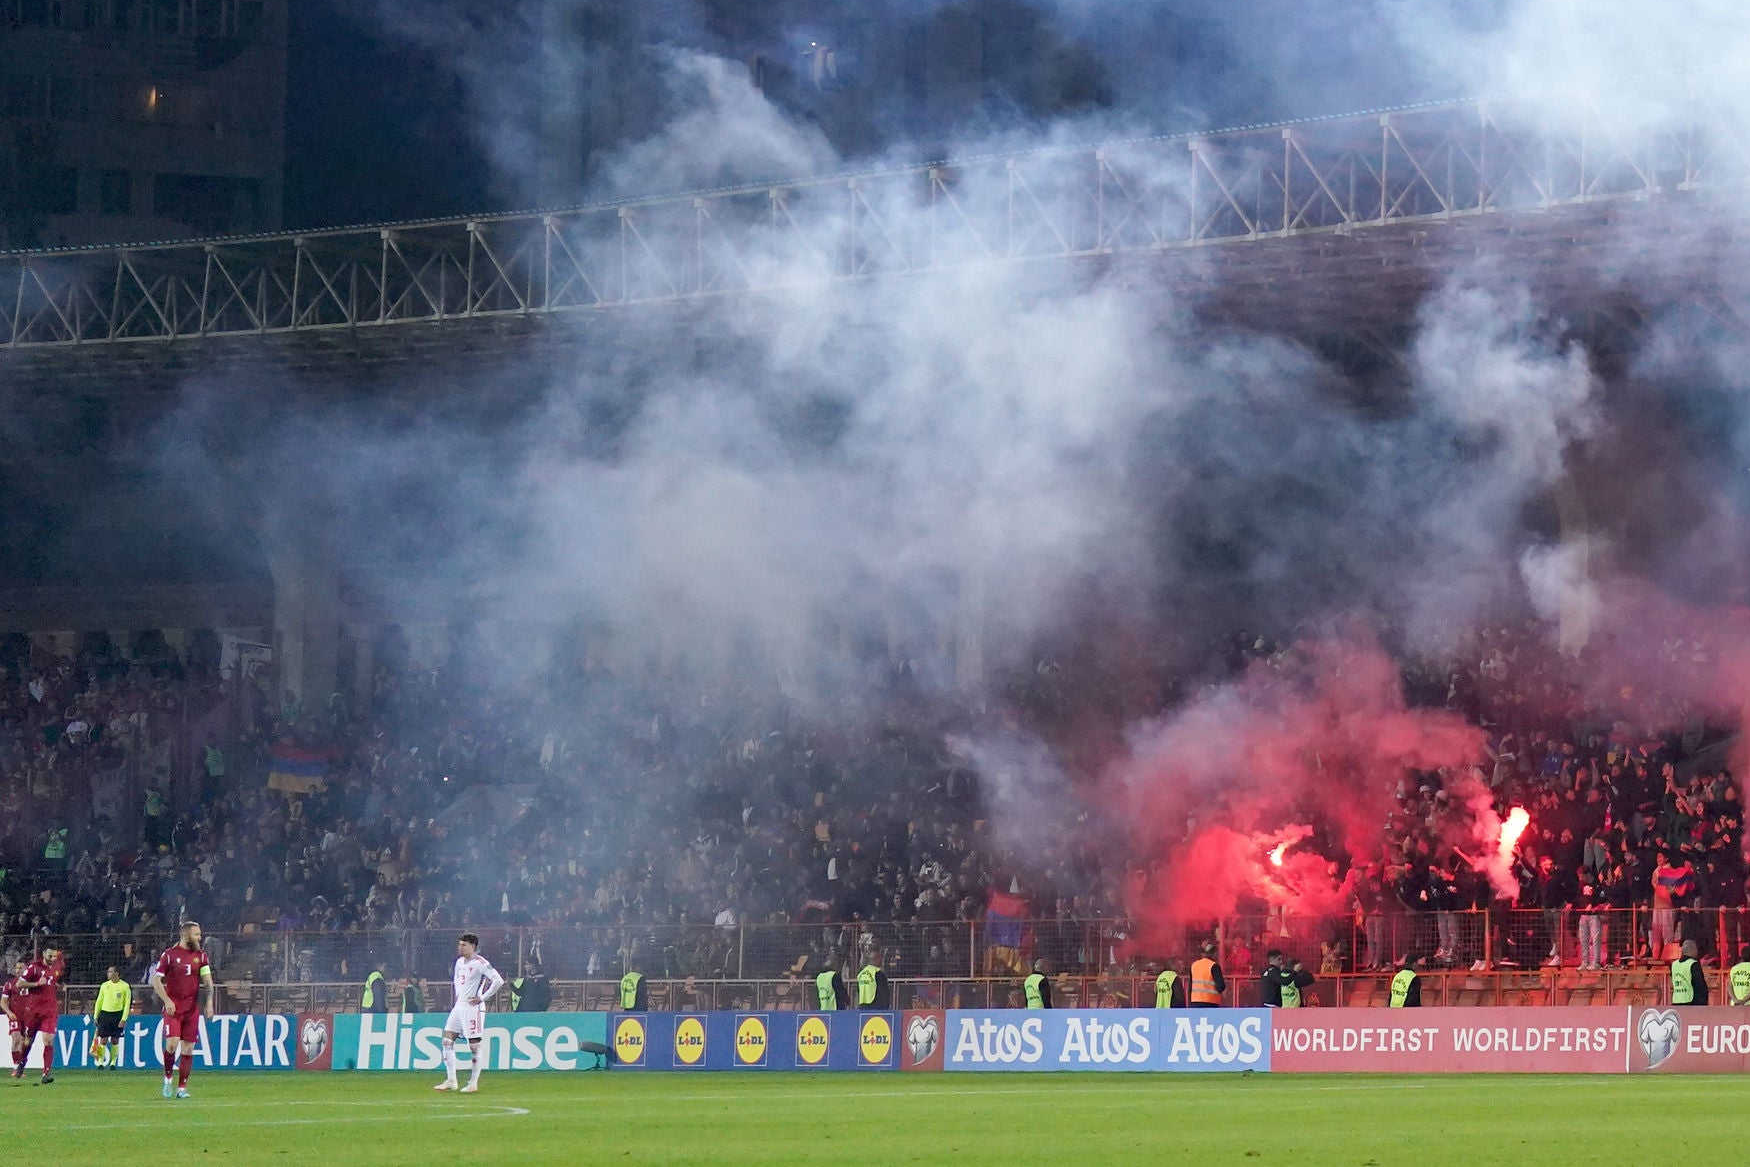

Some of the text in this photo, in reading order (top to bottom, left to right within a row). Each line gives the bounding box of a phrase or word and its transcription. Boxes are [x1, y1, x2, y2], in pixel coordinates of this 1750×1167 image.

[185, 964, 191, 975] 3
[470, 1020, 477, 1030] 3
[56, 1014, 148, 1067] viit
[1273, 1027, 1626, 1052] WORLDFIRST WORLDFIRST
